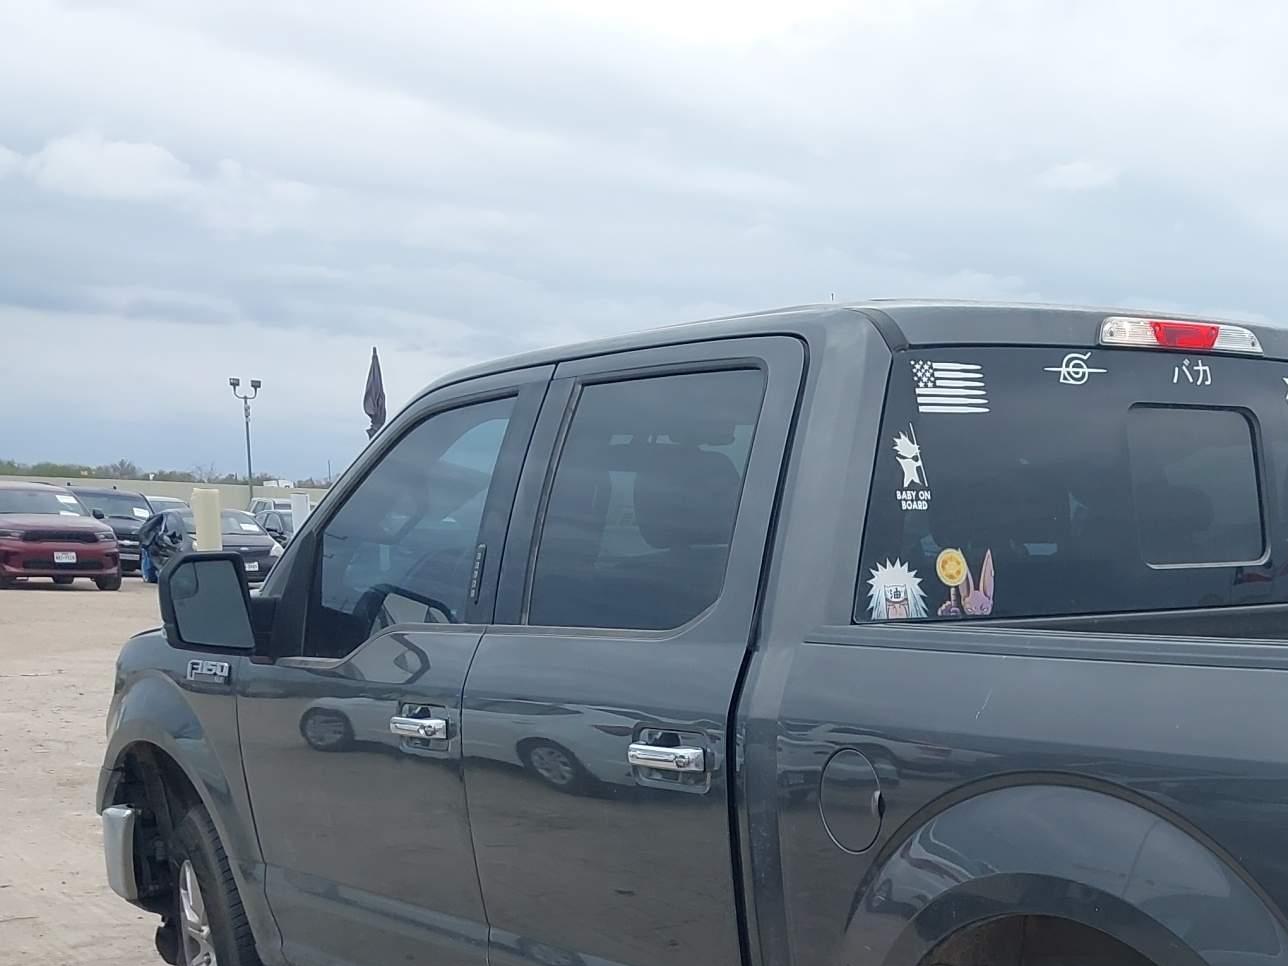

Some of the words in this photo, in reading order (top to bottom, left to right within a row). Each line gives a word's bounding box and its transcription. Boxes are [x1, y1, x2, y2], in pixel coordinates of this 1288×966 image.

[1173, 358, 1212, 386] バカ
[896, 490, 916, 500] BABY
[918, 490, 931, 500] ON
[901, 500, 928, 510] BOARD
